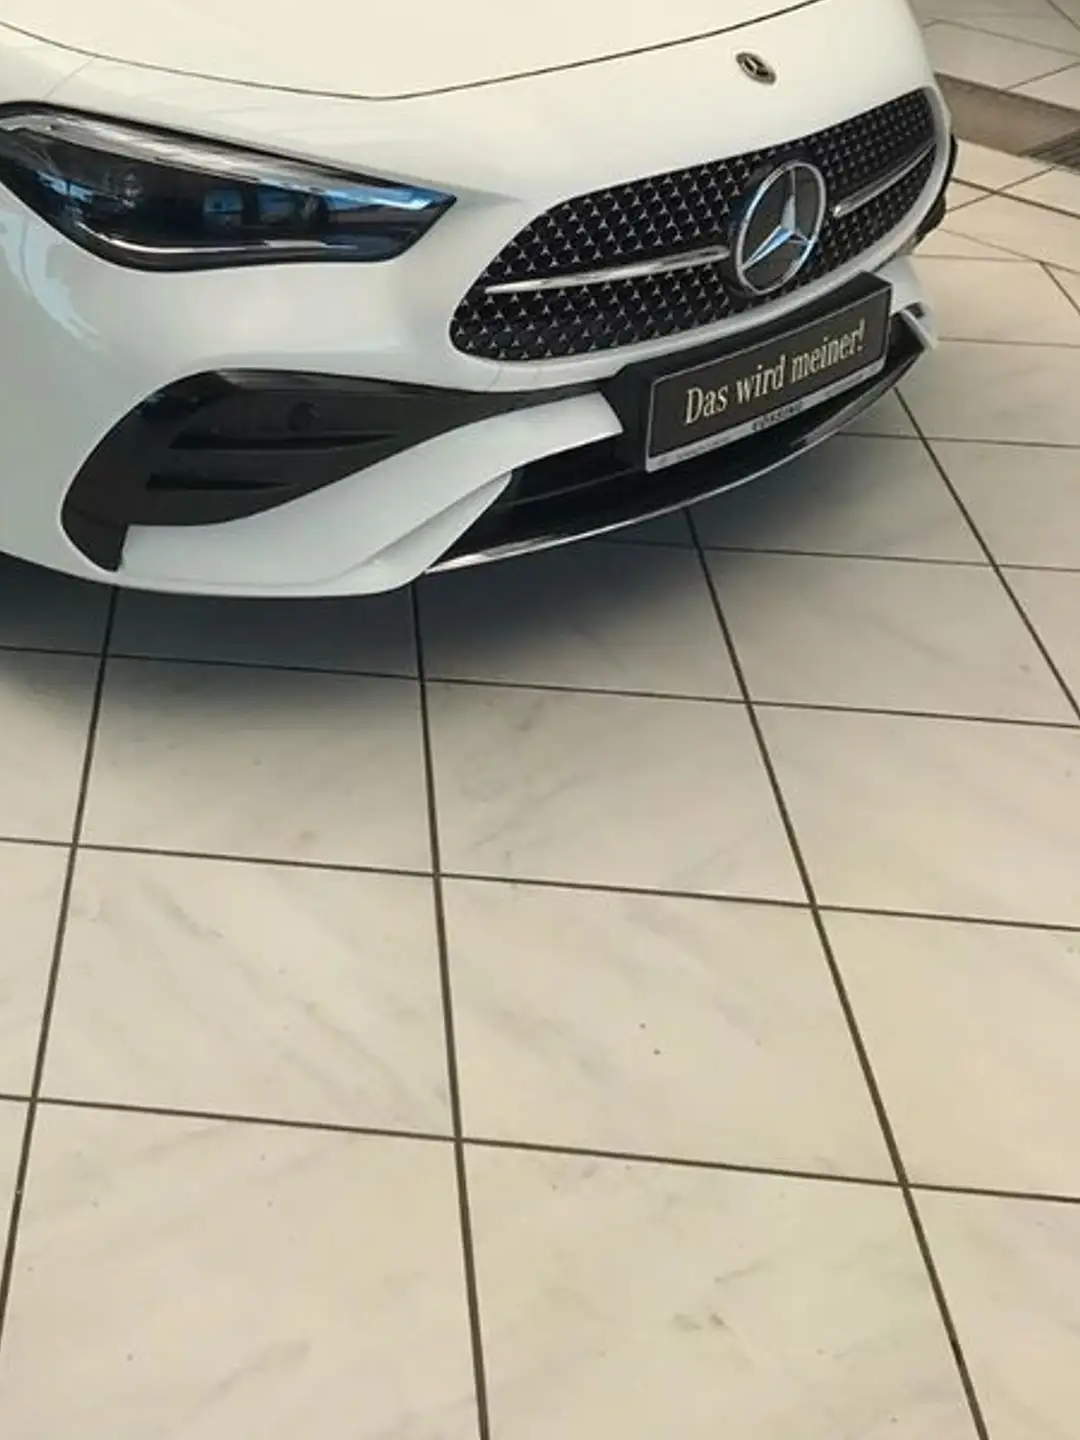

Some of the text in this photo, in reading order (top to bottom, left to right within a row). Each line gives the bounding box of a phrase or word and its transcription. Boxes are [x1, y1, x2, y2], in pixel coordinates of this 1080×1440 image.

[684, 384, 729, 426] Das
[735, 354, 786, 405] wird
[791, 318, 867, 382] meiner!
